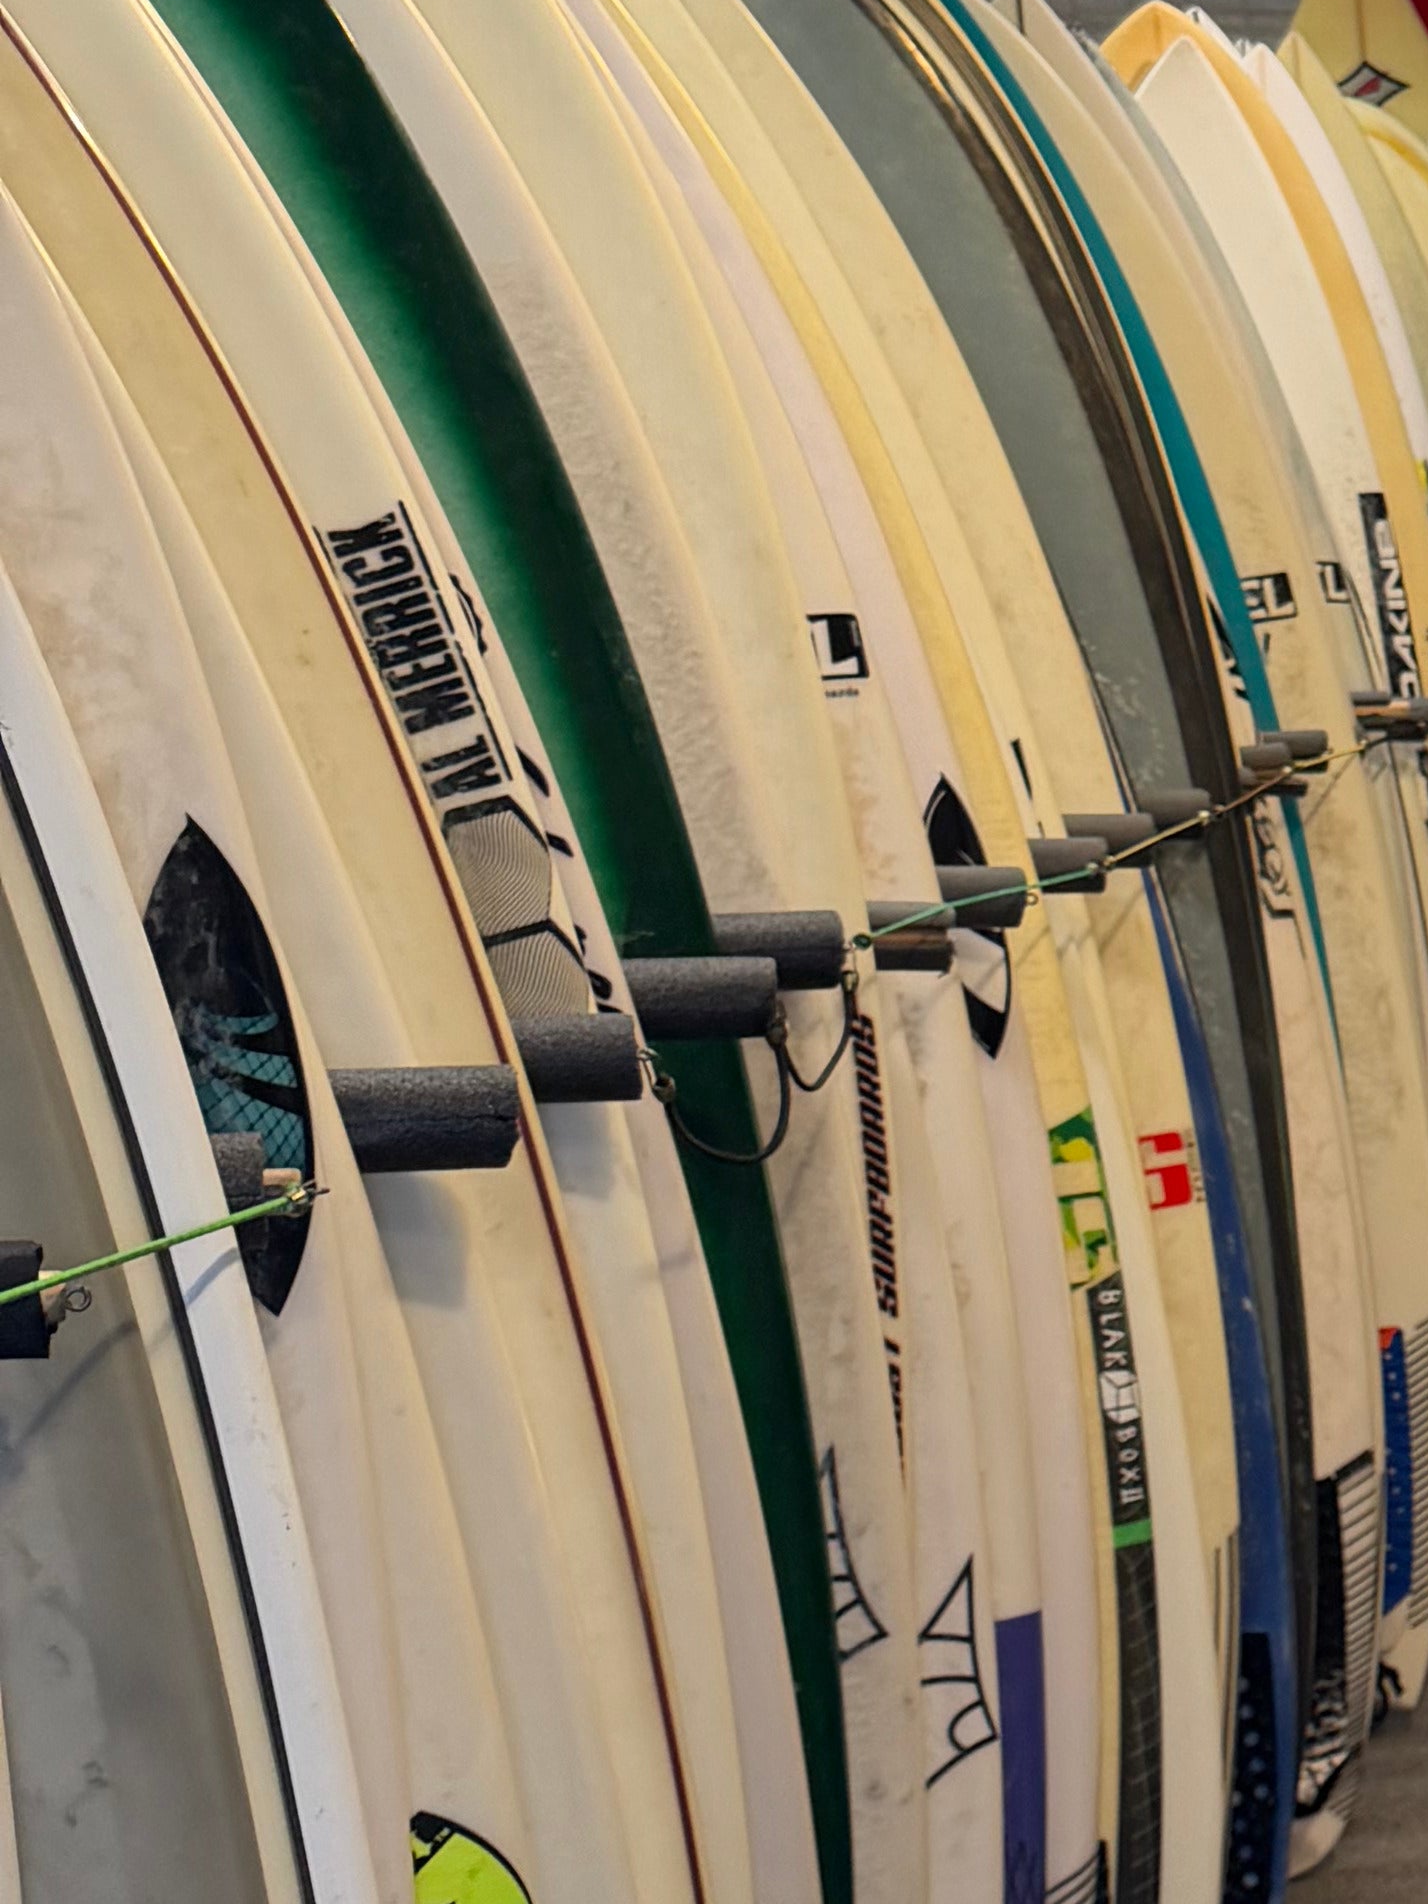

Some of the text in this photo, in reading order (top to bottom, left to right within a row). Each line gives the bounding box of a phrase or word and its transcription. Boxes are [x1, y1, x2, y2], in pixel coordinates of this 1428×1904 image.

[326, 511, 502, 799] AL MERRICK
[1098, 1288, 1128, 1367] BLAK
